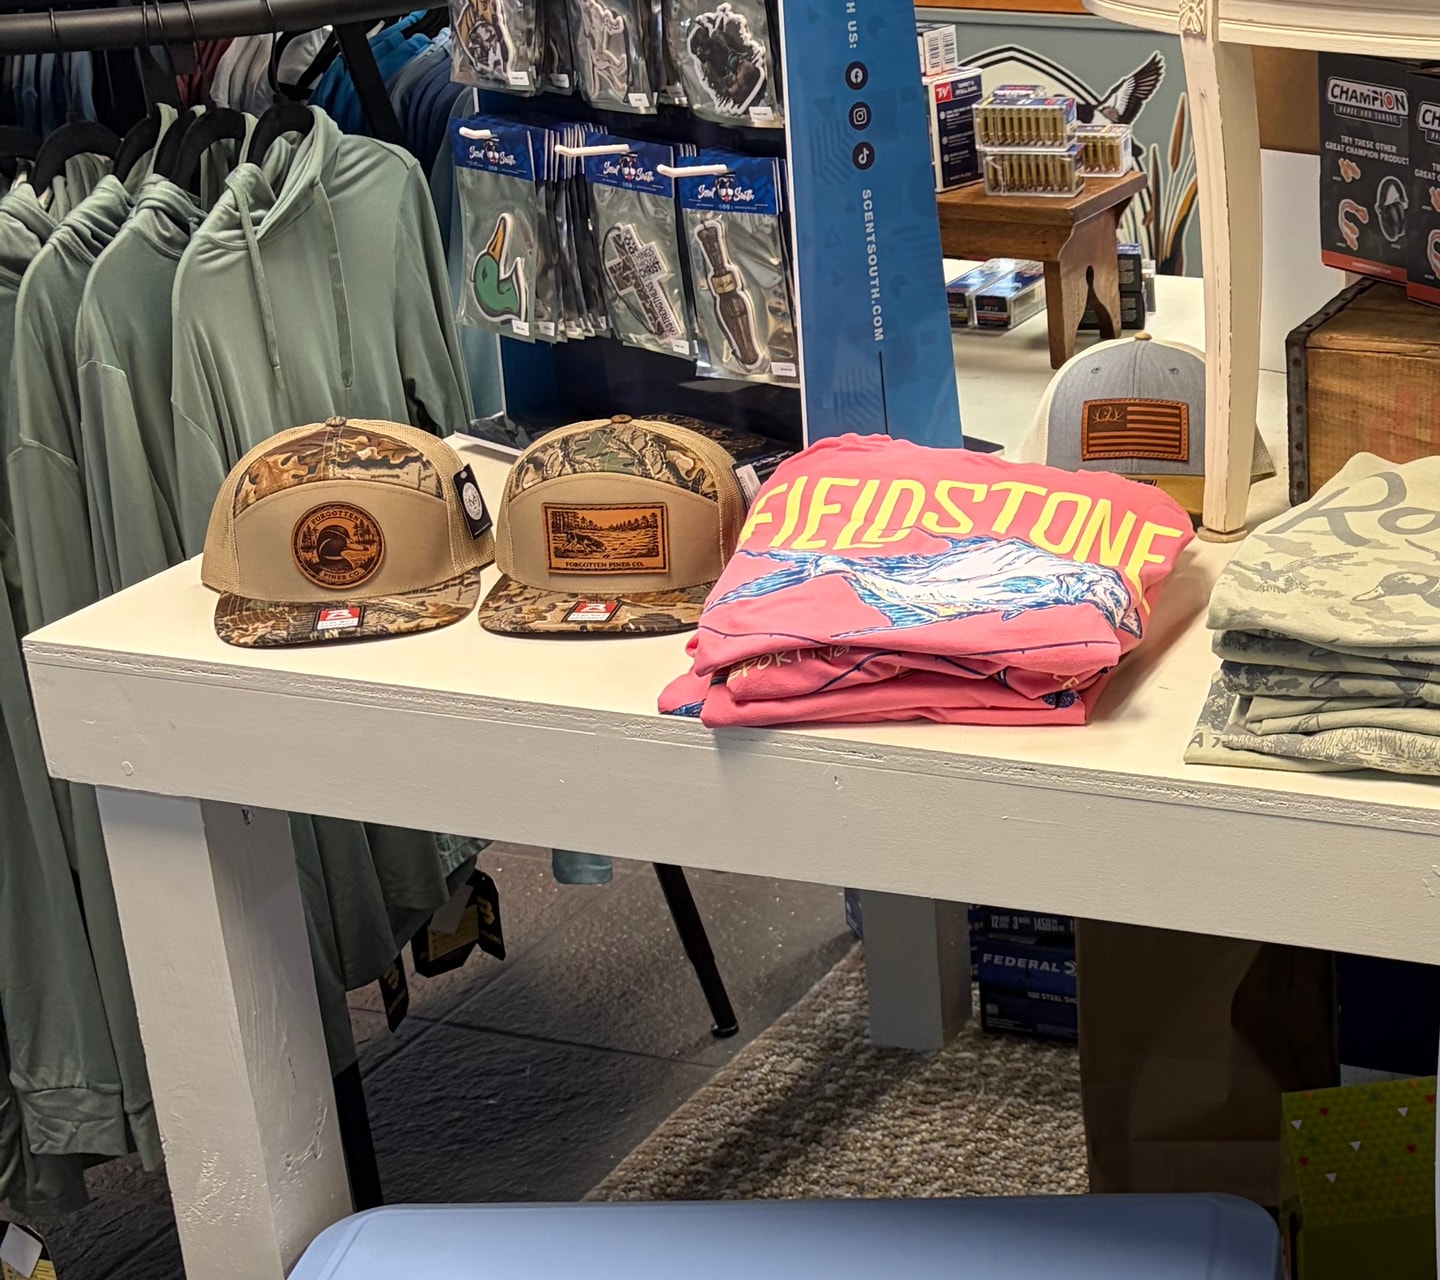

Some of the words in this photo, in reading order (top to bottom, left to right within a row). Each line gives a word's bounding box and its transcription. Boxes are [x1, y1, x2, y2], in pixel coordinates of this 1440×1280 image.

[847, 22, 860, 50] US:
[1331, 83, 1406, 112] CHAMPION
[1325, 142, 1344, 152] GREAT
[1346, 146, 1378, 159] CHAMPION
[1380, 154, 1409, 165] PRODUCT
[1340, 135, 1353, 143] TRY
[1354, 138, 1374, 148] THESE
[1375, 142, 1396, 152] OTHER
[1415, 169, 1436, 180] GREAT
[861, 187, 885, 343] SCENTSOUTH.COM
[312, 510, 360, 524] FORGOTTEN
[736, 474, 1184, 617] FIELDSTONE
[983, 953, 1061, 973] FEDERAL
